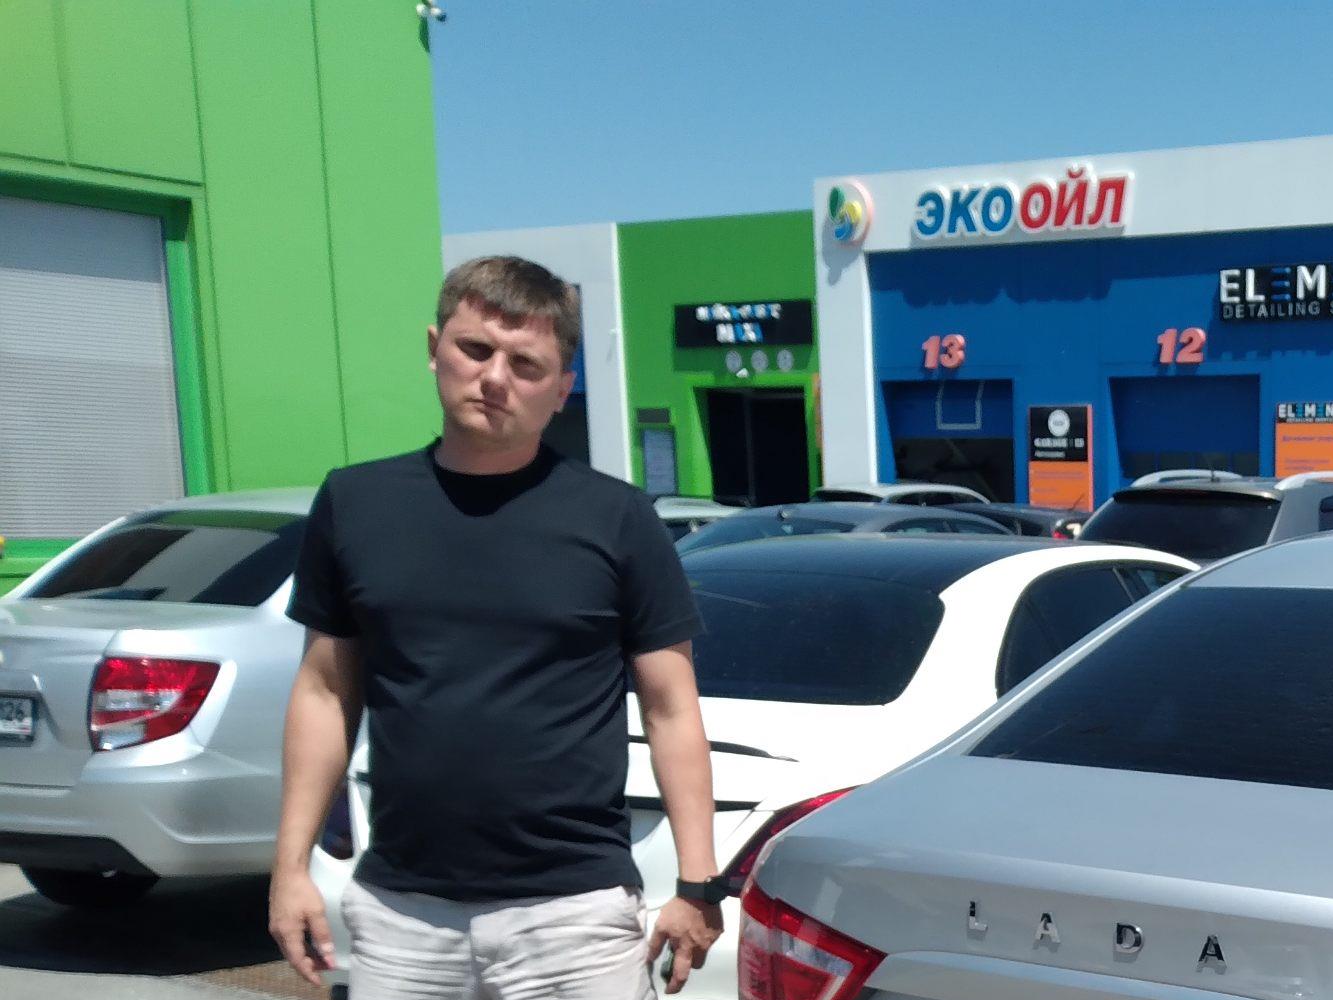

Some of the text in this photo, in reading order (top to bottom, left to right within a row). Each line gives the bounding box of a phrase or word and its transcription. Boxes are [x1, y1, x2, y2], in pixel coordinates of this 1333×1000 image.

[1222, 300, 1321, 320] DETAILING
[921, 334, 967, 370] 13
[1156, 327, 1207, 364] 12
[968, 900, 1228, 967] LADA
